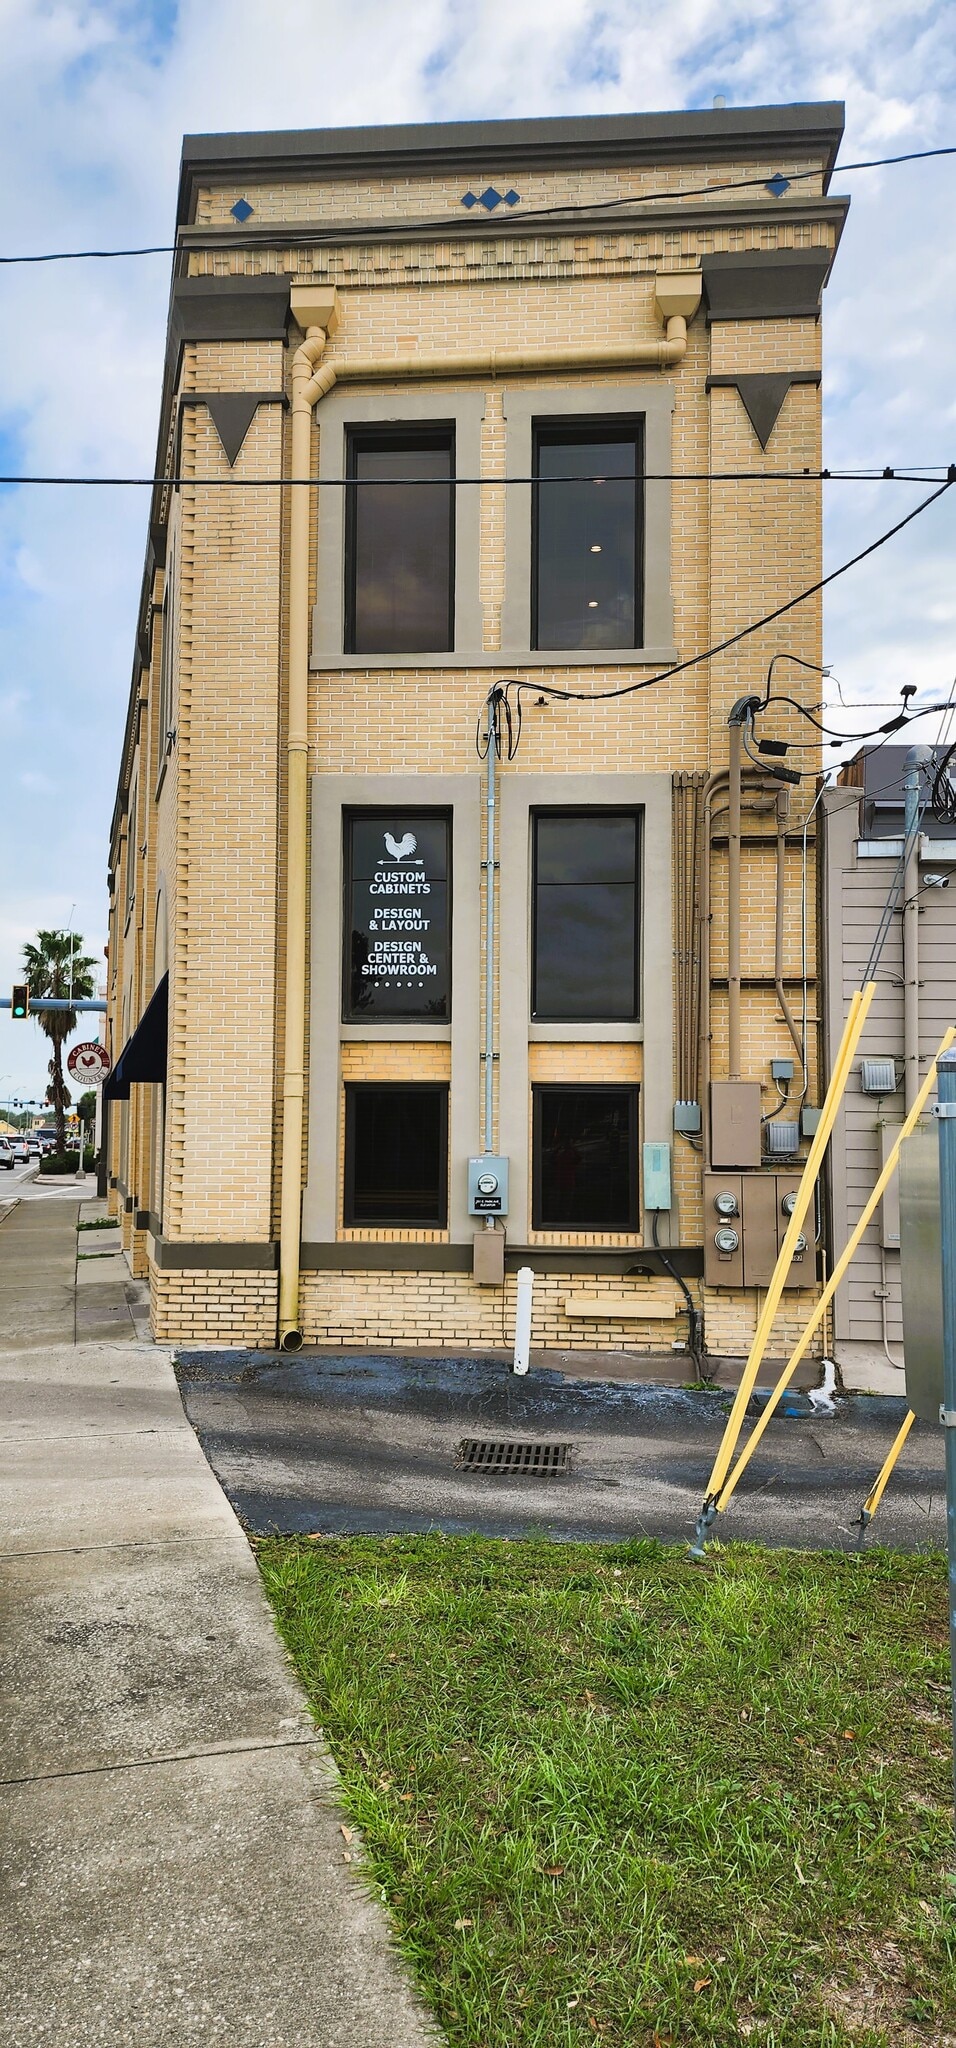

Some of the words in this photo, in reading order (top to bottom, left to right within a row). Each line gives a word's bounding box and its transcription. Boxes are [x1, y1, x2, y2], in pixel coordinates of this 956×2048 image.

[374, 872, 425, 882] CUSTOM
[369, 884, 431, 894] CABINETS
[374, 909, 421, 919] DESIGN
[369, 920, 379, 930] &
[382, 920, 430, 930] LAYOUT
[374, 942, 421, 952] DESIGN
[367, 953, 415, 963] CENTER
[419, 953, 429, 963] &
[361, 965, 437, 975] SHOWROOM
[72, 1044, 105, 1056] CABINET
[73, 1072, 106, 1082] COUNTRY
